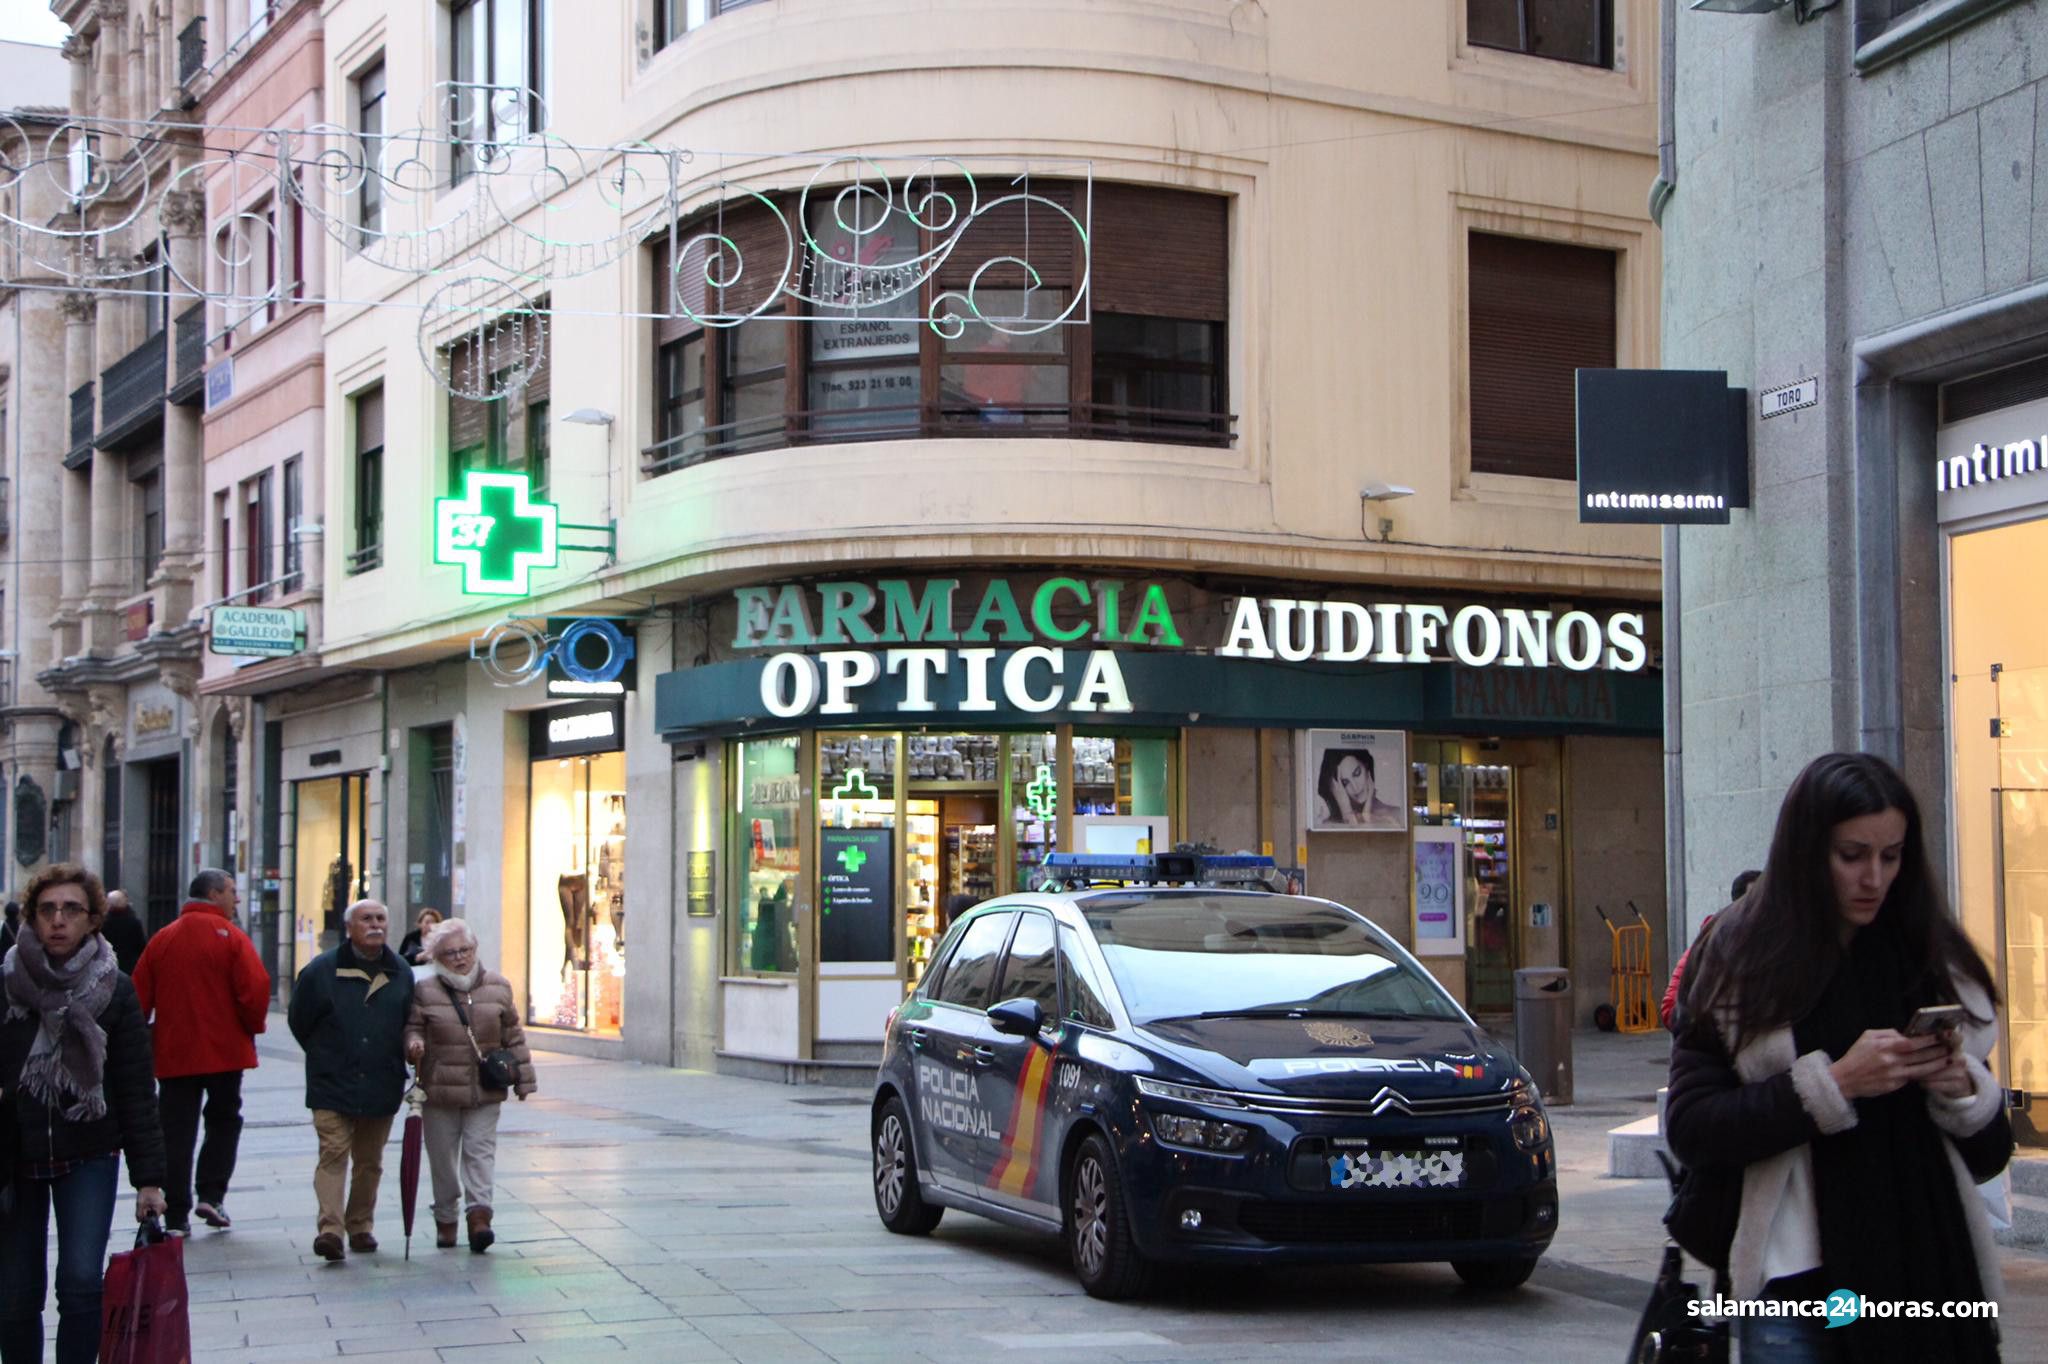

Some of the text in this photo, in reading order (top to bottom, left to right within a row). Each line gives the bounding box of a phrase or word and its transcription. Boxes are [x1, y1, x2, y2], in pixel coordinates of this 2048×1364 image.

[823, 333, 911, 350] EXTRANJEROS
[848, 380, 866, 391] 923
[870, 378, 881, 389] 21
[1777, 388, 1801, 408] TORO
[1587, 491, 1724, 509] intimissimi
[223, 611, 286, 625] ACADEMIA
[732, 577, 1184, 648] FARMACIA
[229, 625, 279, 638] GALILEO
[1215, 596, 1647, 672] AUDIFONOS
[760, 645, 1134, 718] OPTICA
[1455, 668, 1613, 721] FARMACIA
[1341, 733, 1375, 741] DARPHIN
[1286, 1057, 1462, 1074] POLICIA
[920, 1065, 980, 1102] POLICIA
[921, 1097, 1000, 1140] NACIONAL
